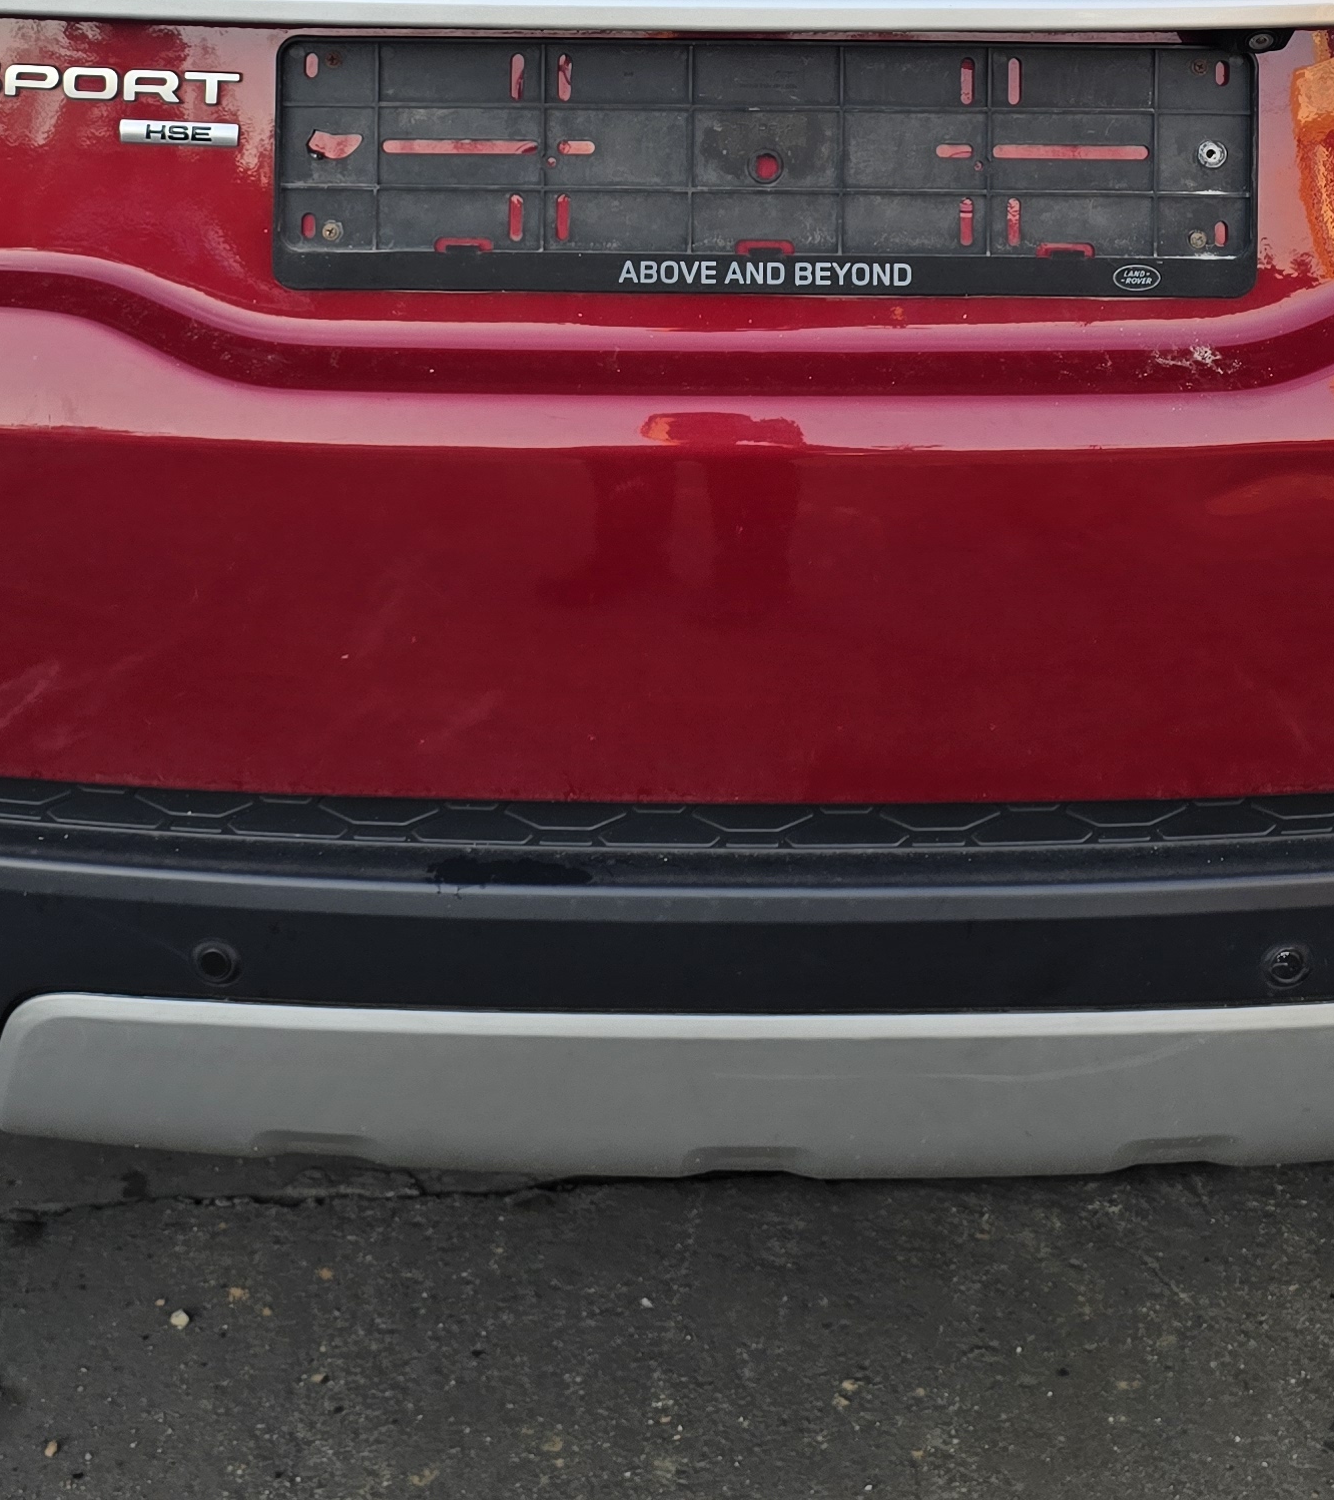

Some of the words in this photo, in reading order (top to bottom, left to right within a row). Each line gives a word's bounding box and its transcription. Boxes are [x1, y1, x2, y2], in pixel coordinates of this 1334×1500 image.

[145, 123, 213, 142] HSE
[618, 260, 717, 284] ABOVE
[724, 261, 786, 285] AND
[794, 262, 913, 287] BEYOND
[1125, 277, 1153, 285] ROVER
